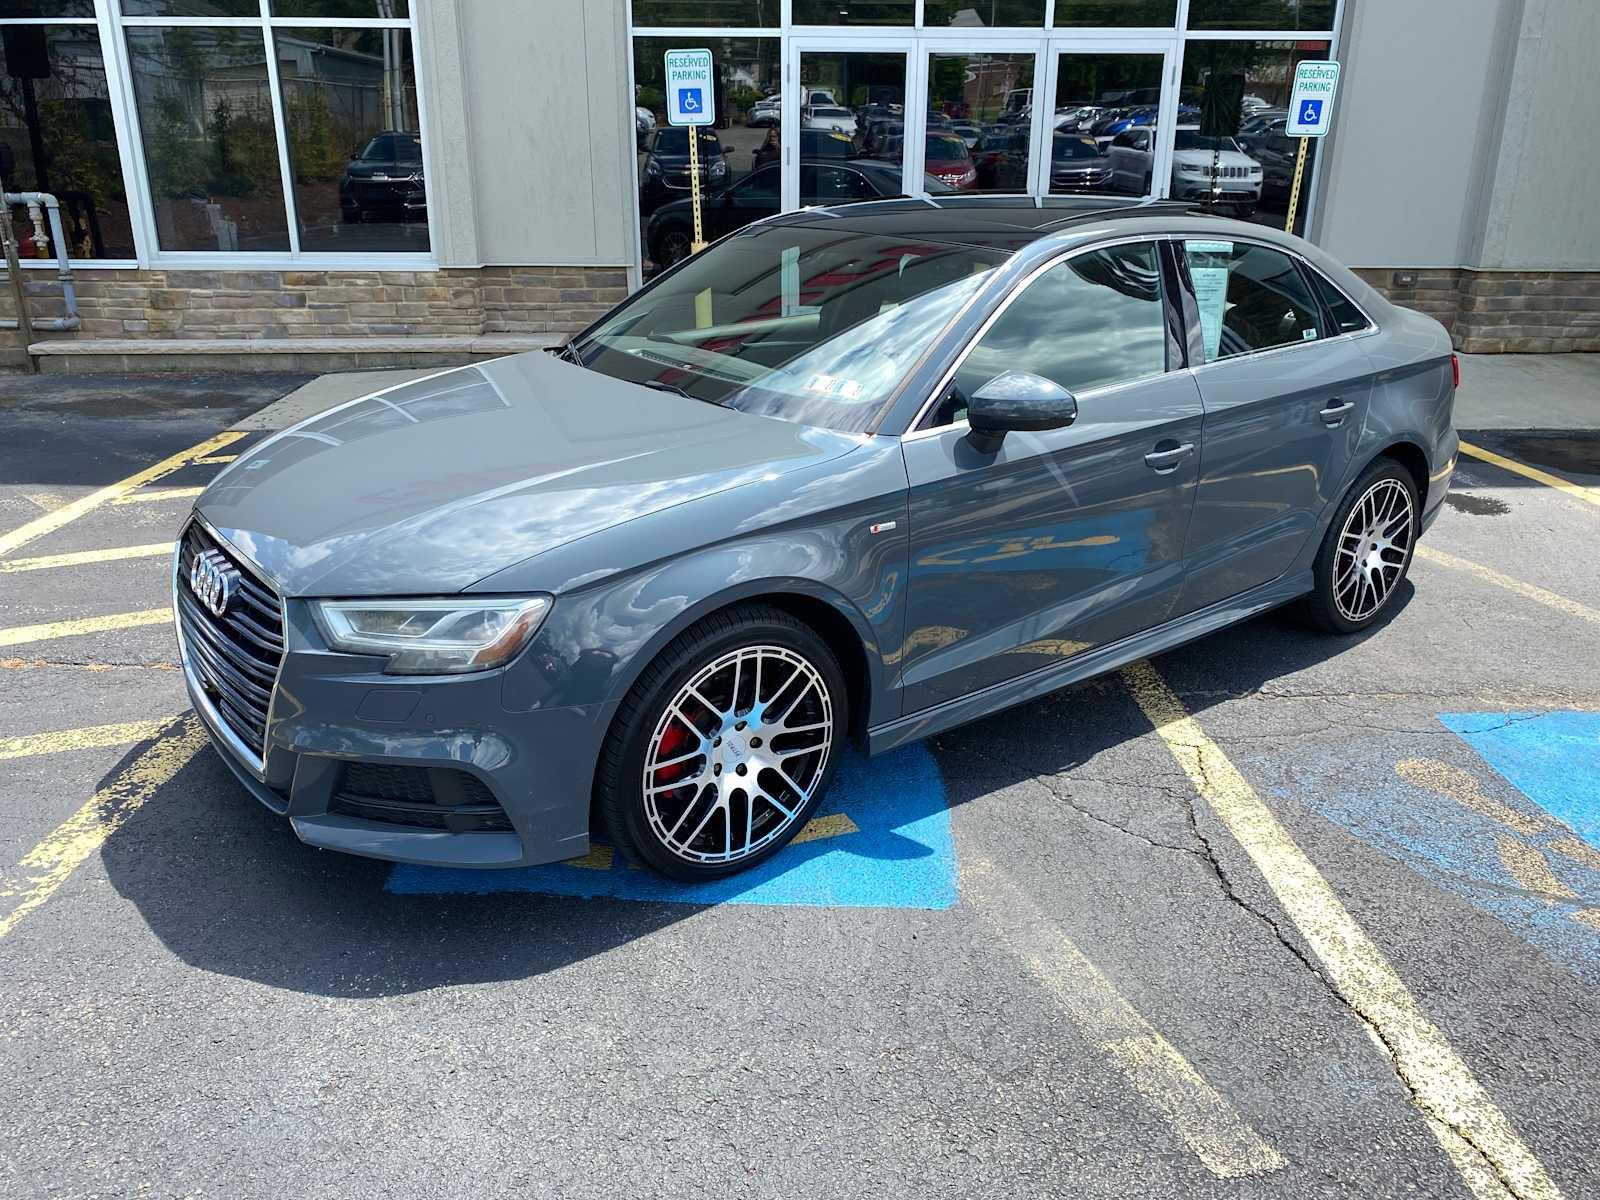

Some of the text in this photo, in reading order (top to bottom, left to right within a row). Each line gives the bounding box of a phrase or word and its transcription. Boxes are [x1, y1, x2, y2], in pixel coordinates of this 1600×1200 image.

[669, 57, 708, 68] RESERVED
[672, 70, 707, 80] PARKING
[1298, 69, 1336, 80] RESERVED
[1299, 82, 1331, 92] PARKING
